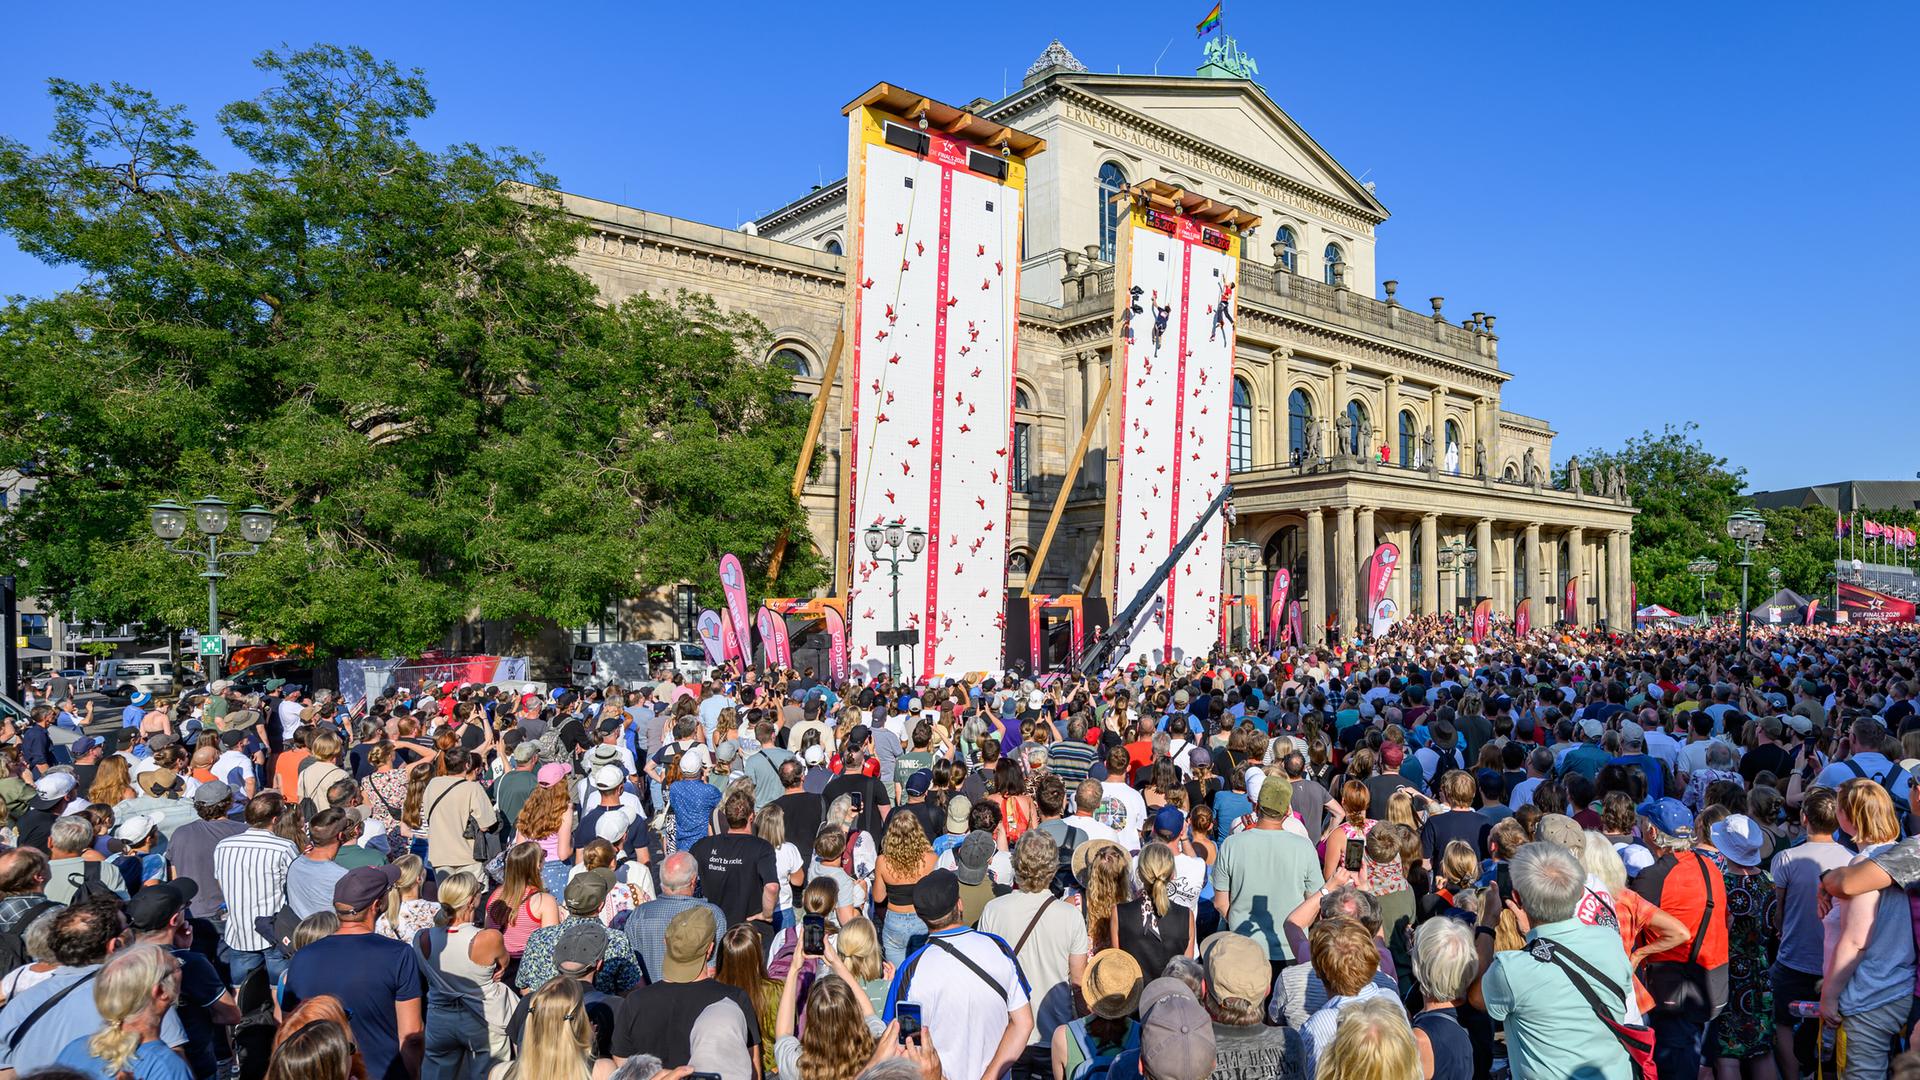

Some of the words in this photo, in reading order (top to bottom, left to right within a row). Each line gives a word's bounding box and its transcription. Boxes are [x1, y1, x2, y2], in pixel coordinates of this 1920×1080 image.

[1066, 105, 1128, 140] ERNESTUS
[1130, 133, 1185, 163] AUGUSTUS
[1193, 154, 1213, 174] REX
[1378, 566, 1391, 591] SPEED
